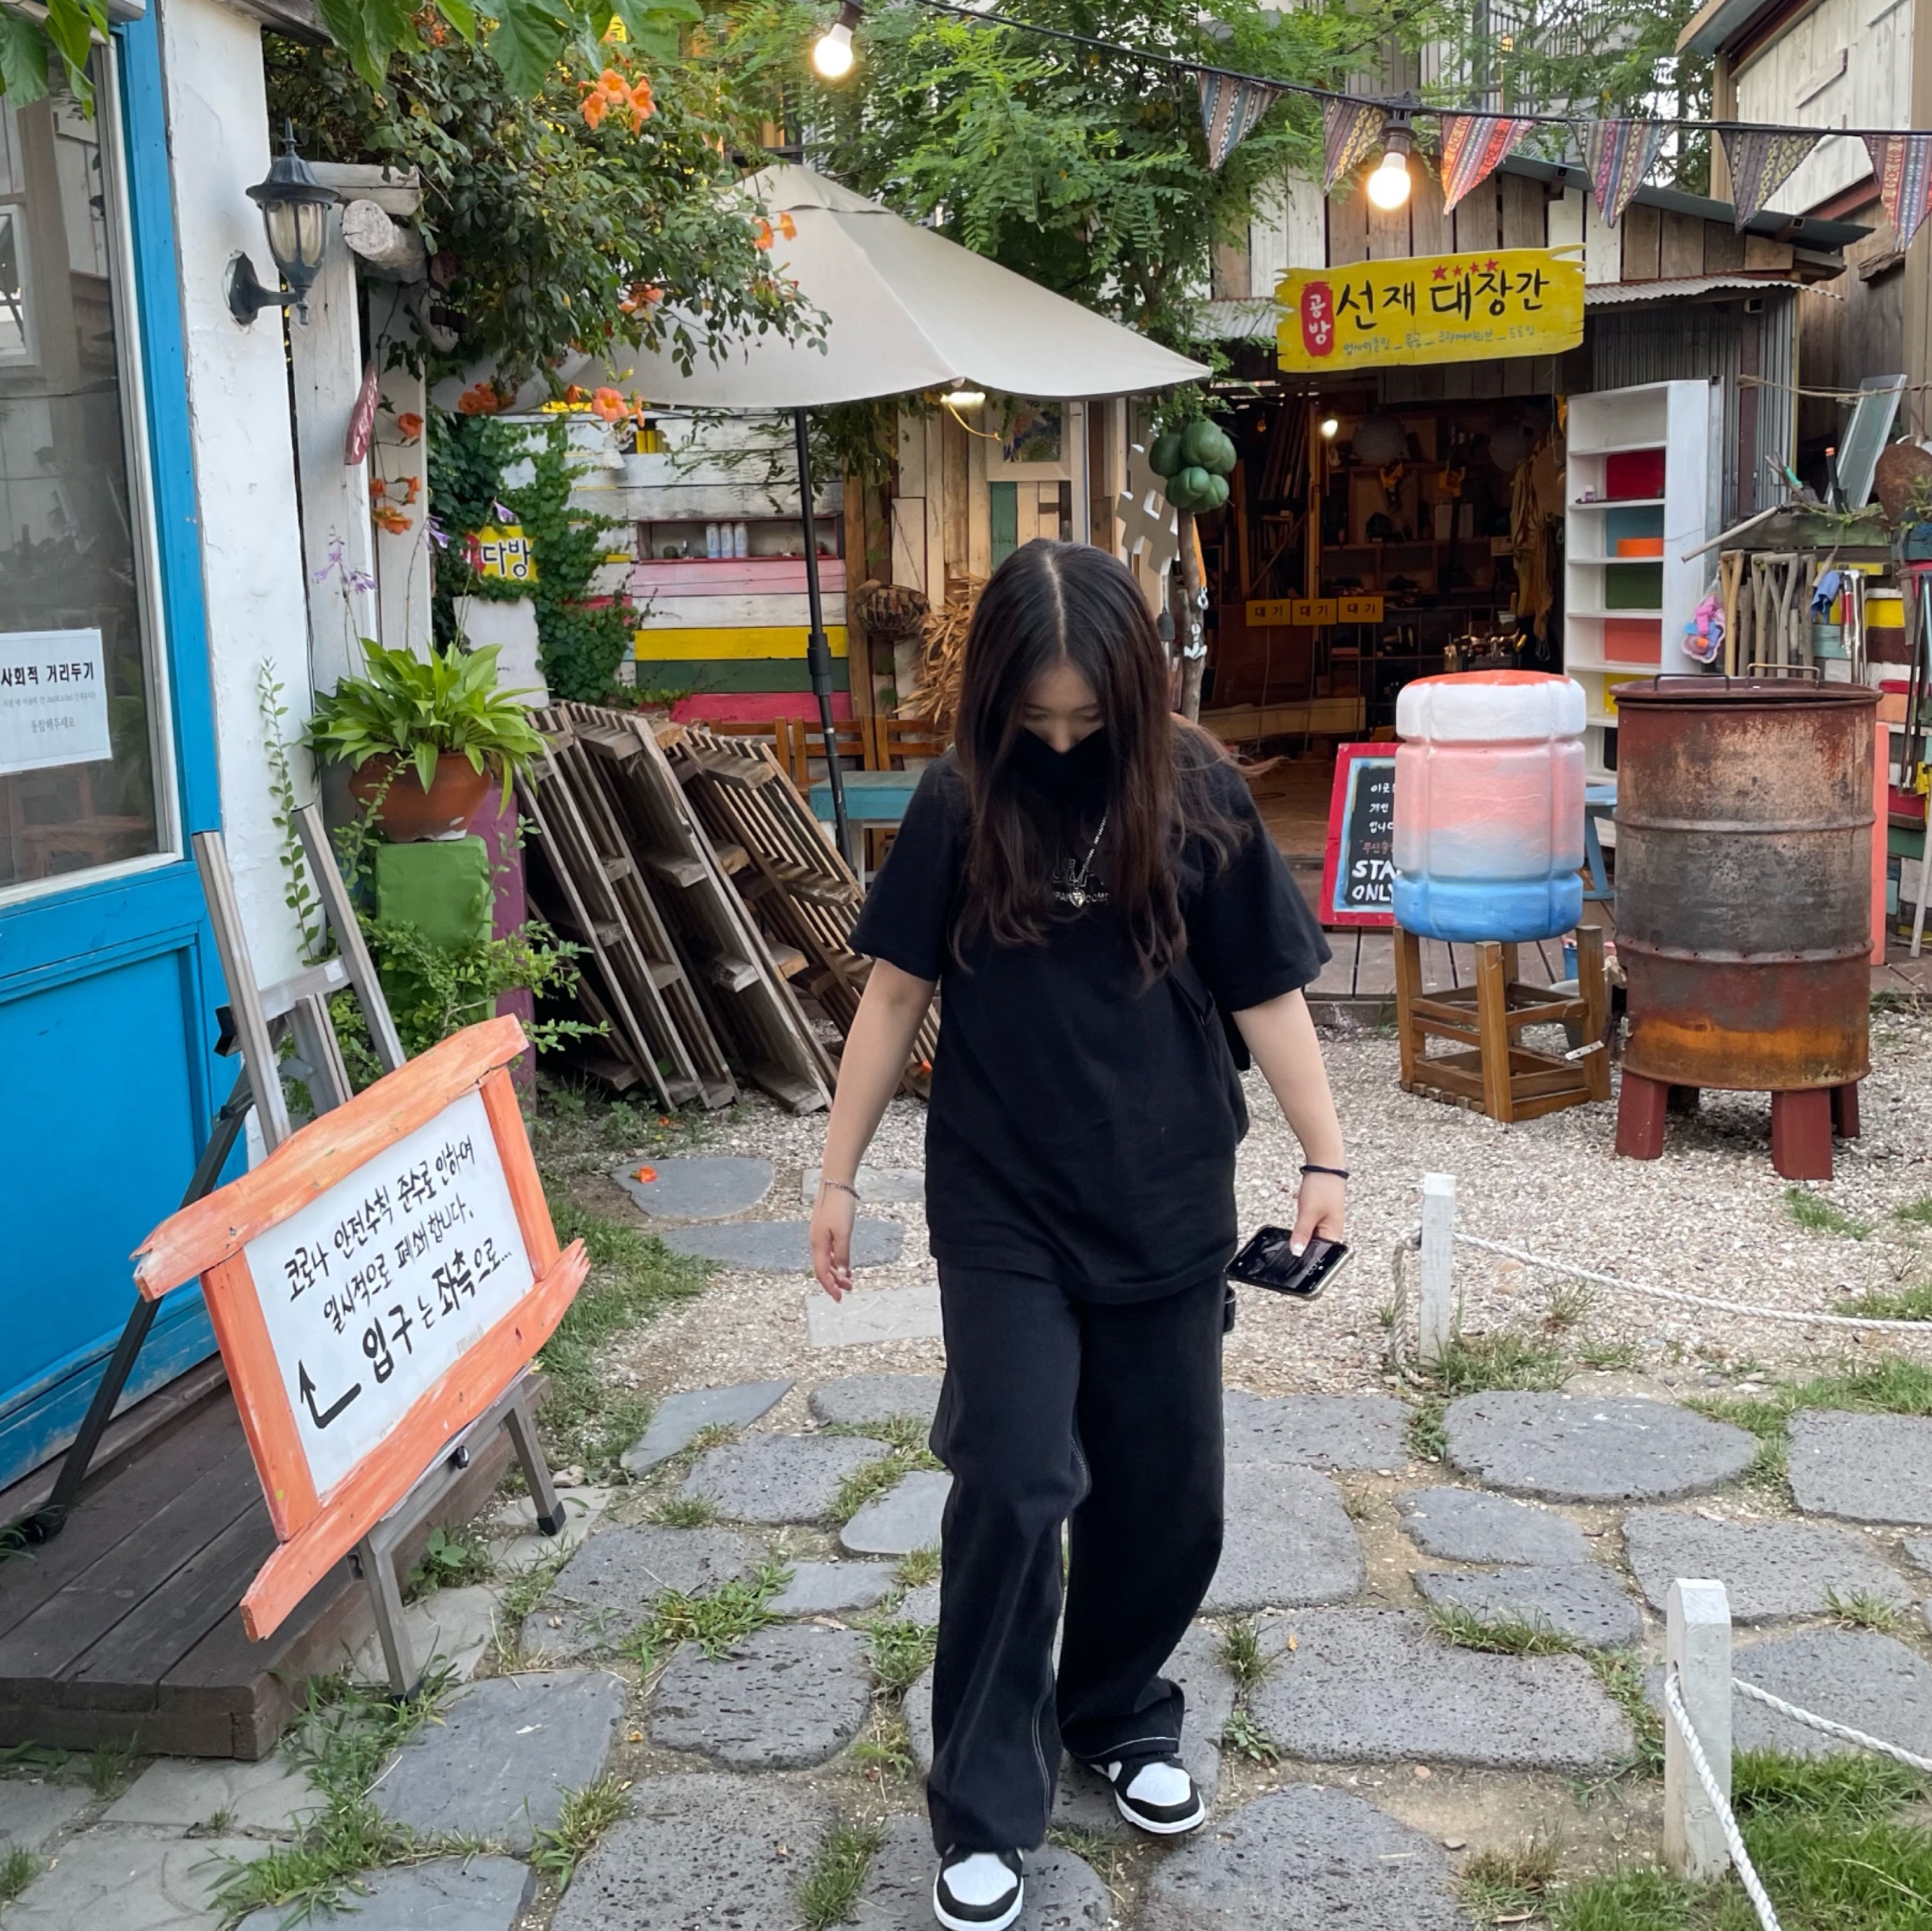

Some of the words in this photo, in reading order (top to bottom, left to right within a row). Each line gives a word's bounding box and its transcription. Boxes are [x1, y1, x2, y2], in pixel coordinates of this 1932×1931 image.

[1307, 293, 1332, 345] 공방
[1336, 280, 1416, 330] 선재
[1429, 268, 1550, 322] 대장간
[482, 538, 531, 578] 다방
[1, 665, 39, 686] 사회적
[46, 661, 94, 684] 거리두기
[1370, 782, 1395, 794] 이곳
[1351, 859, 1402, 880] STA
[284, 1241, 330, 1302] 코로나
[334, 1185, 393, 1259] 안전수칙
[397, 1159, 436, 1214] 준수로
[436, 1134, 475, 1185] 인하여
[324, 1253, 393, 1335] 일시적으로
